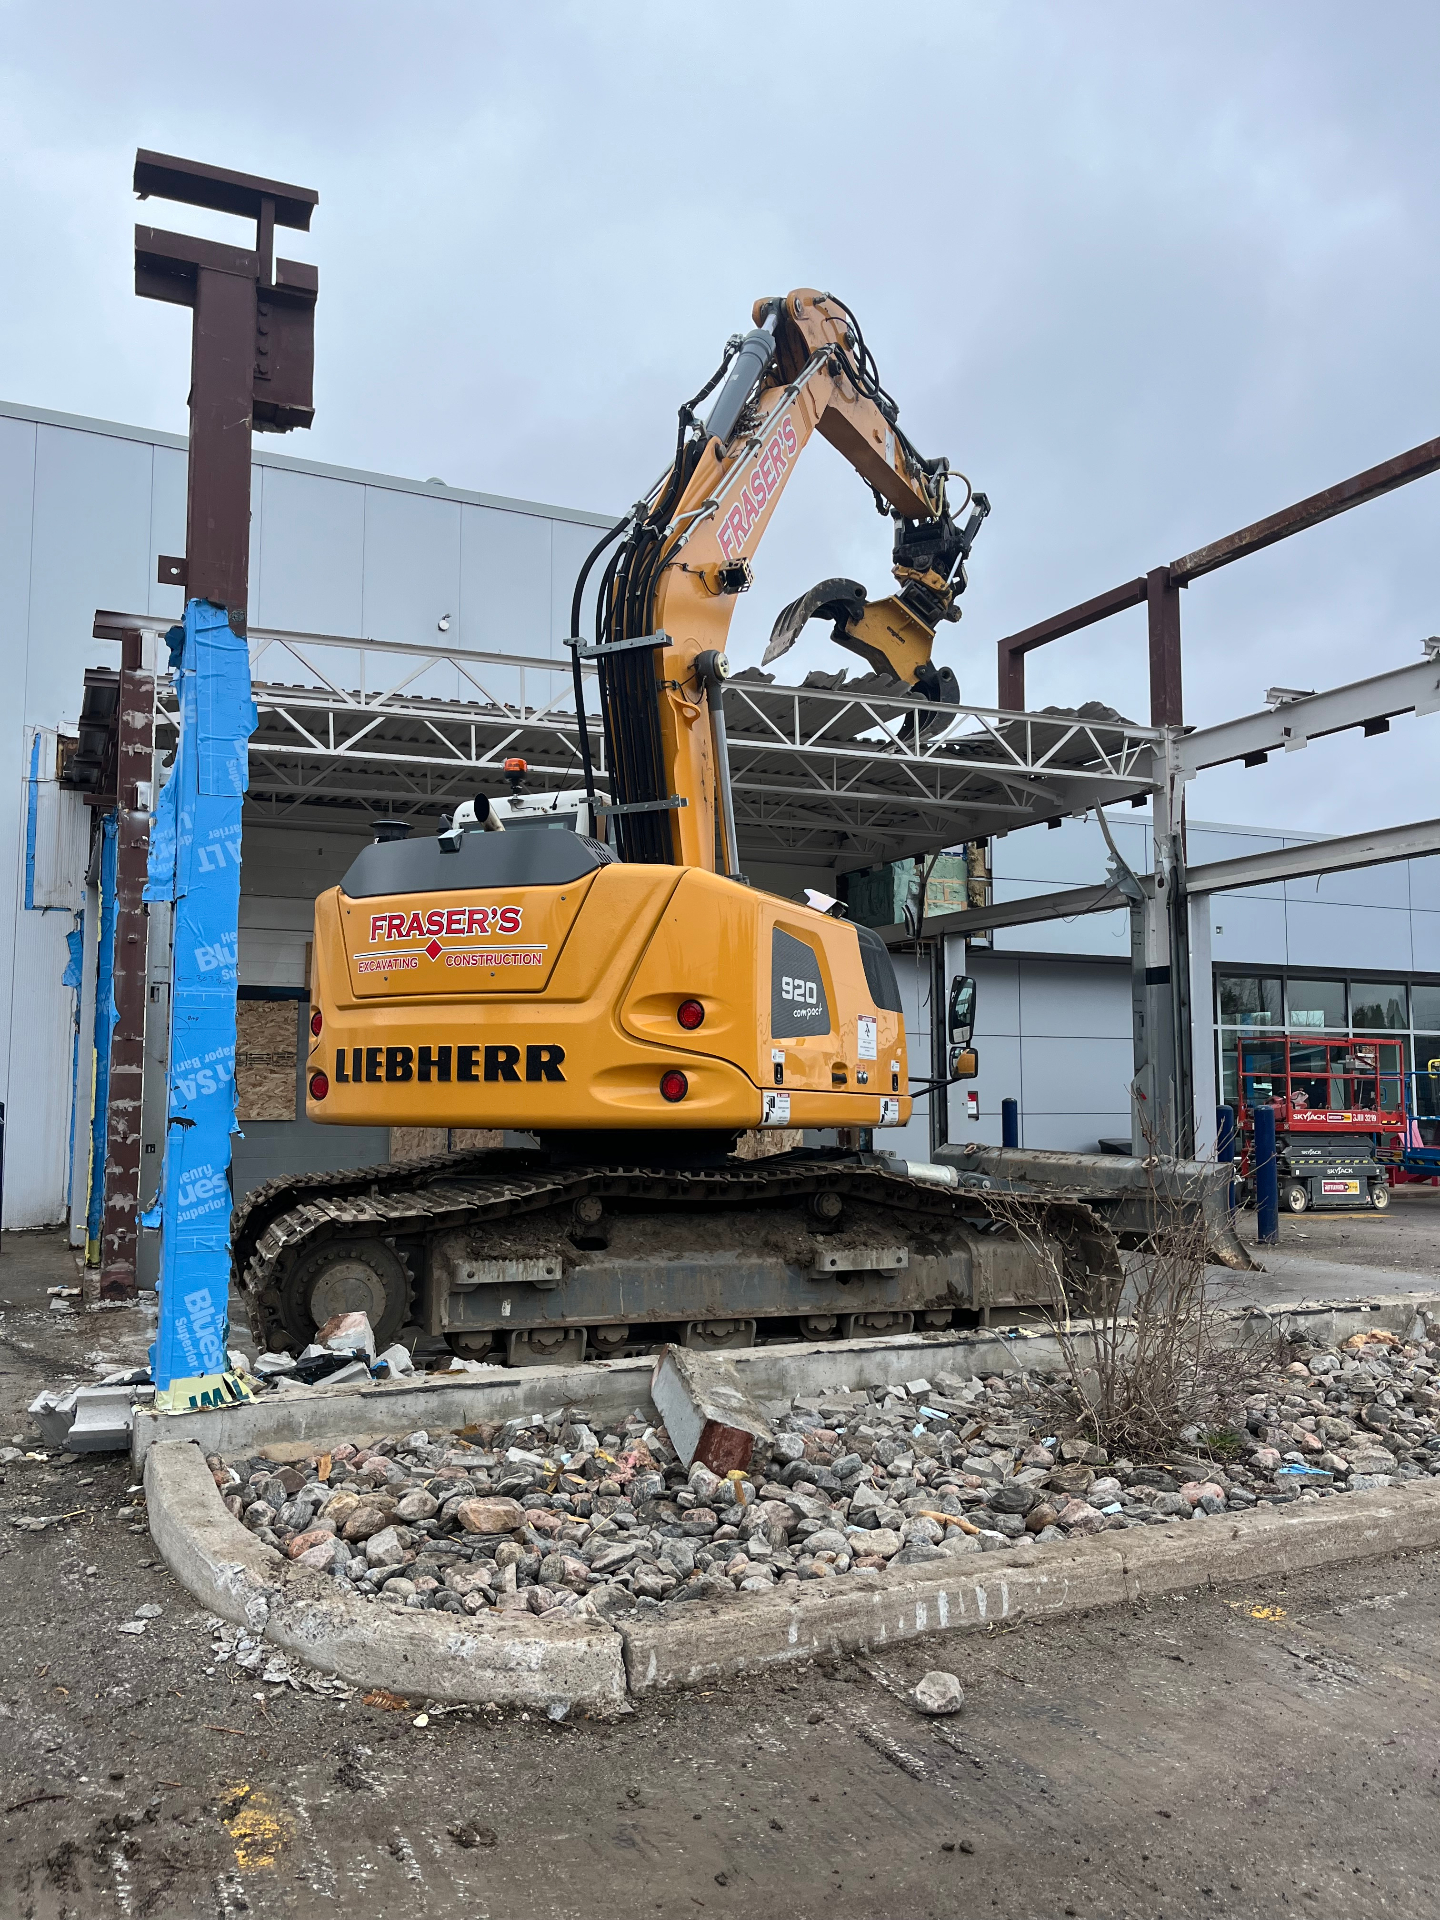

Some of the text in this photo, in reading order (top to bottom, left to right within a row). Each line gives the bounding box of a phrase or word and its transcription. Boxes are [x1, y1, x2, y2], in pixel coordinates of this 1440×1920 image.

[716, 414, 797, 561] FRASER'S
[369, 907, 523, 942] FRASER'S
[358, 953, 542, 973] EXCAVATING CONSTRUCTION
[781, 976, 817, 1005] 920
[793, 1002, 823, 1020] compact
[335, 1044, 568, 1083] LIEBHERR
[1293, 1111, 1326, 1121] SKYJACK
[175, 1317, 199, 1367] Superior
